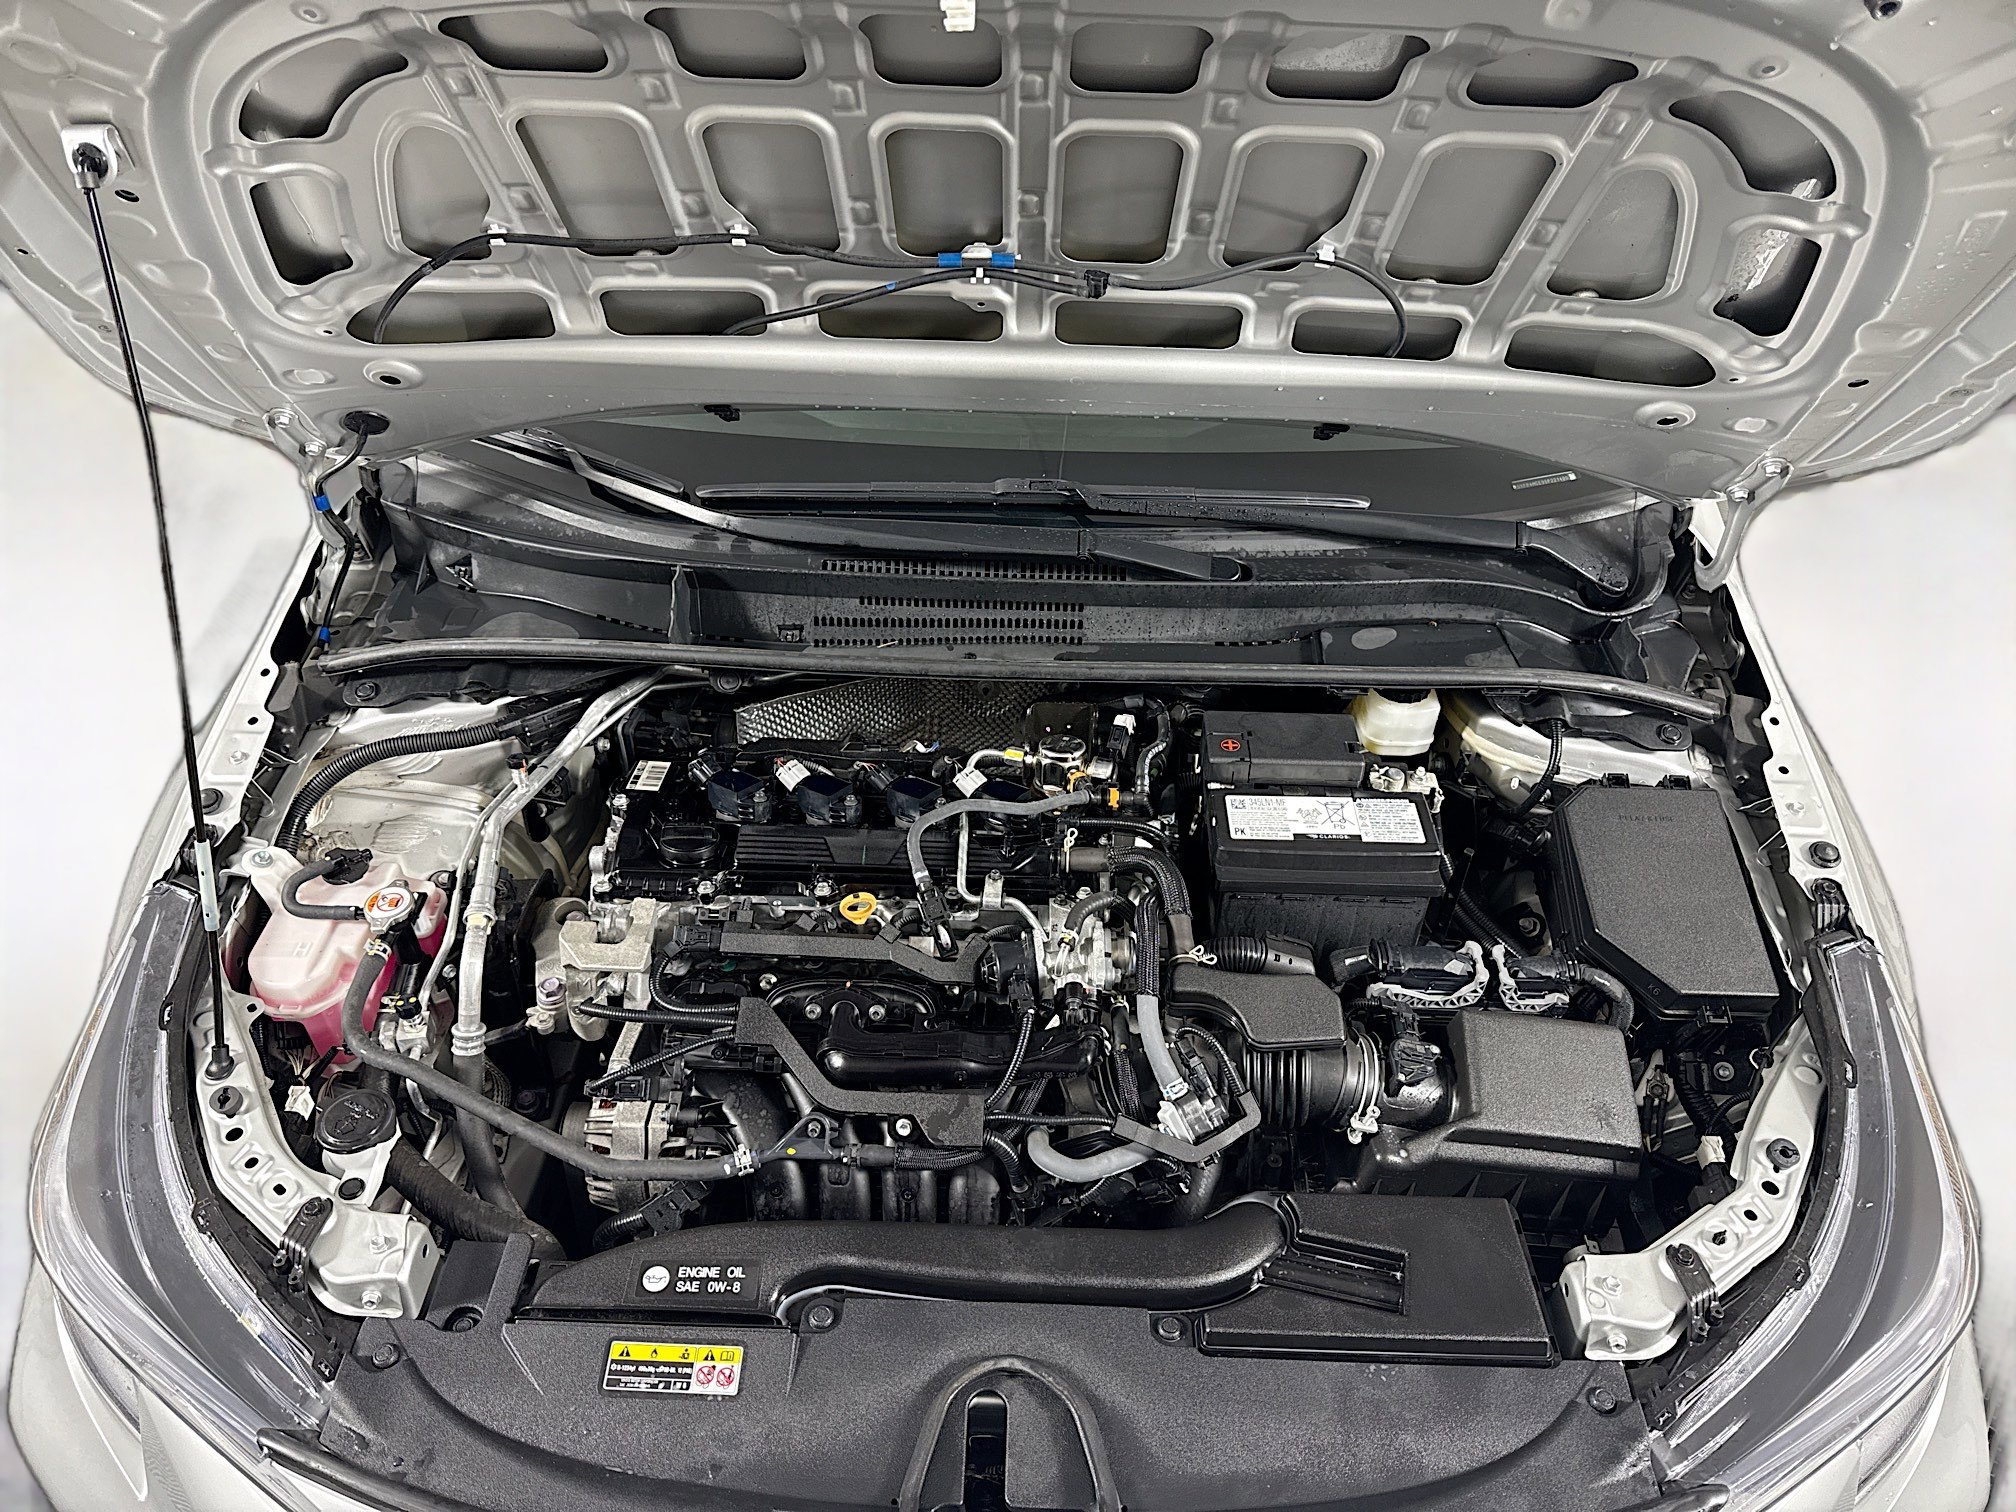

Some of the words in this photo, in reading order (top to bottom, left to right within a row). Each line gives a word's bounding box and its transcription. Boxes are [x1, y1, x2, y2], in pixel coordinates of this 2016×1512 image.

[1234, 827, 1247, 836] PK
[677, 1266, 721, 1279] ENGINE
[726, 1266, 746, 1279] OIL
[675, 1281, 701, 1293] SAE
[707, 1281, 741, 1293] 0W-8
